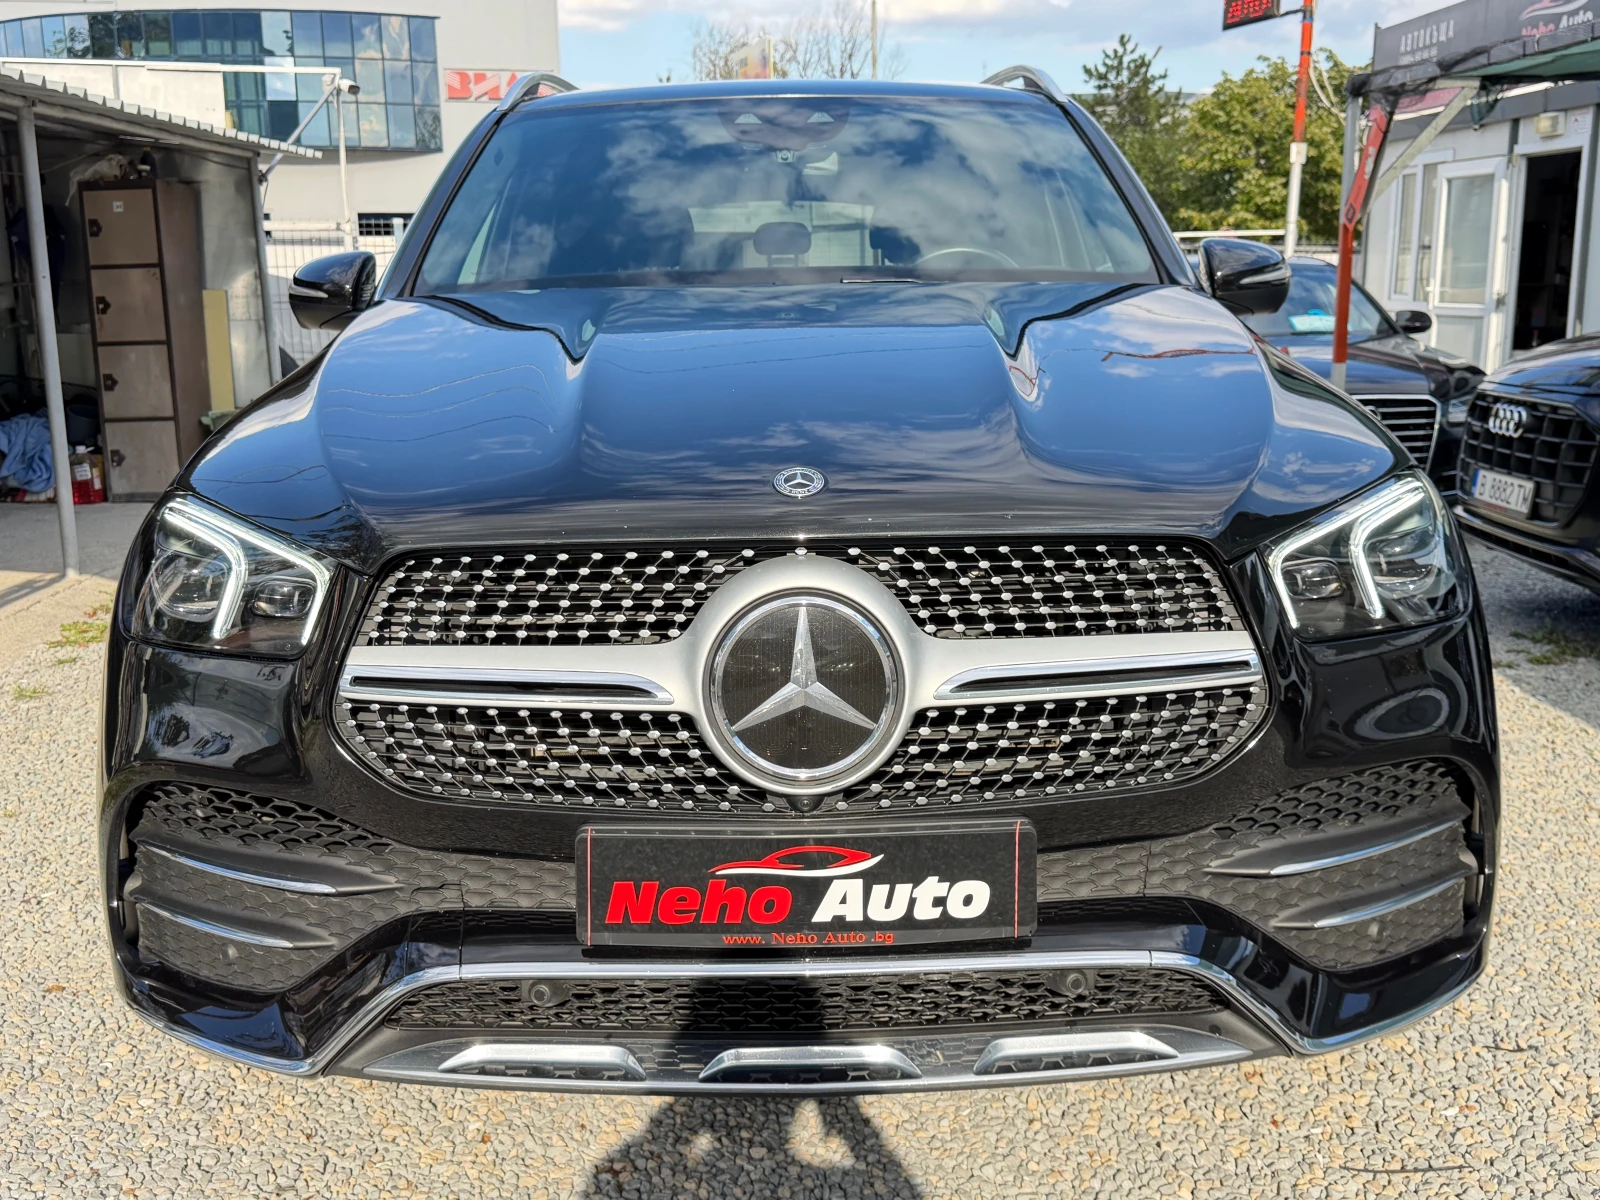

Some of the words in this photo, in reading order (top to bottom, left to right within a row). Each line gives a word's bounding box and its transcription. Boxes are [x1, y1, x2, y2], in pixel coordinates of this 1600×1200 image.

[605, 879, 793, 924] Neho
[811, 876, 991, 922] Auto
[722, 935, 766, 944] www.
[771, 932, 818, 944] Neho
[822, 932, 866, 943] Auto
[871, 931, 895, 944] .bg
